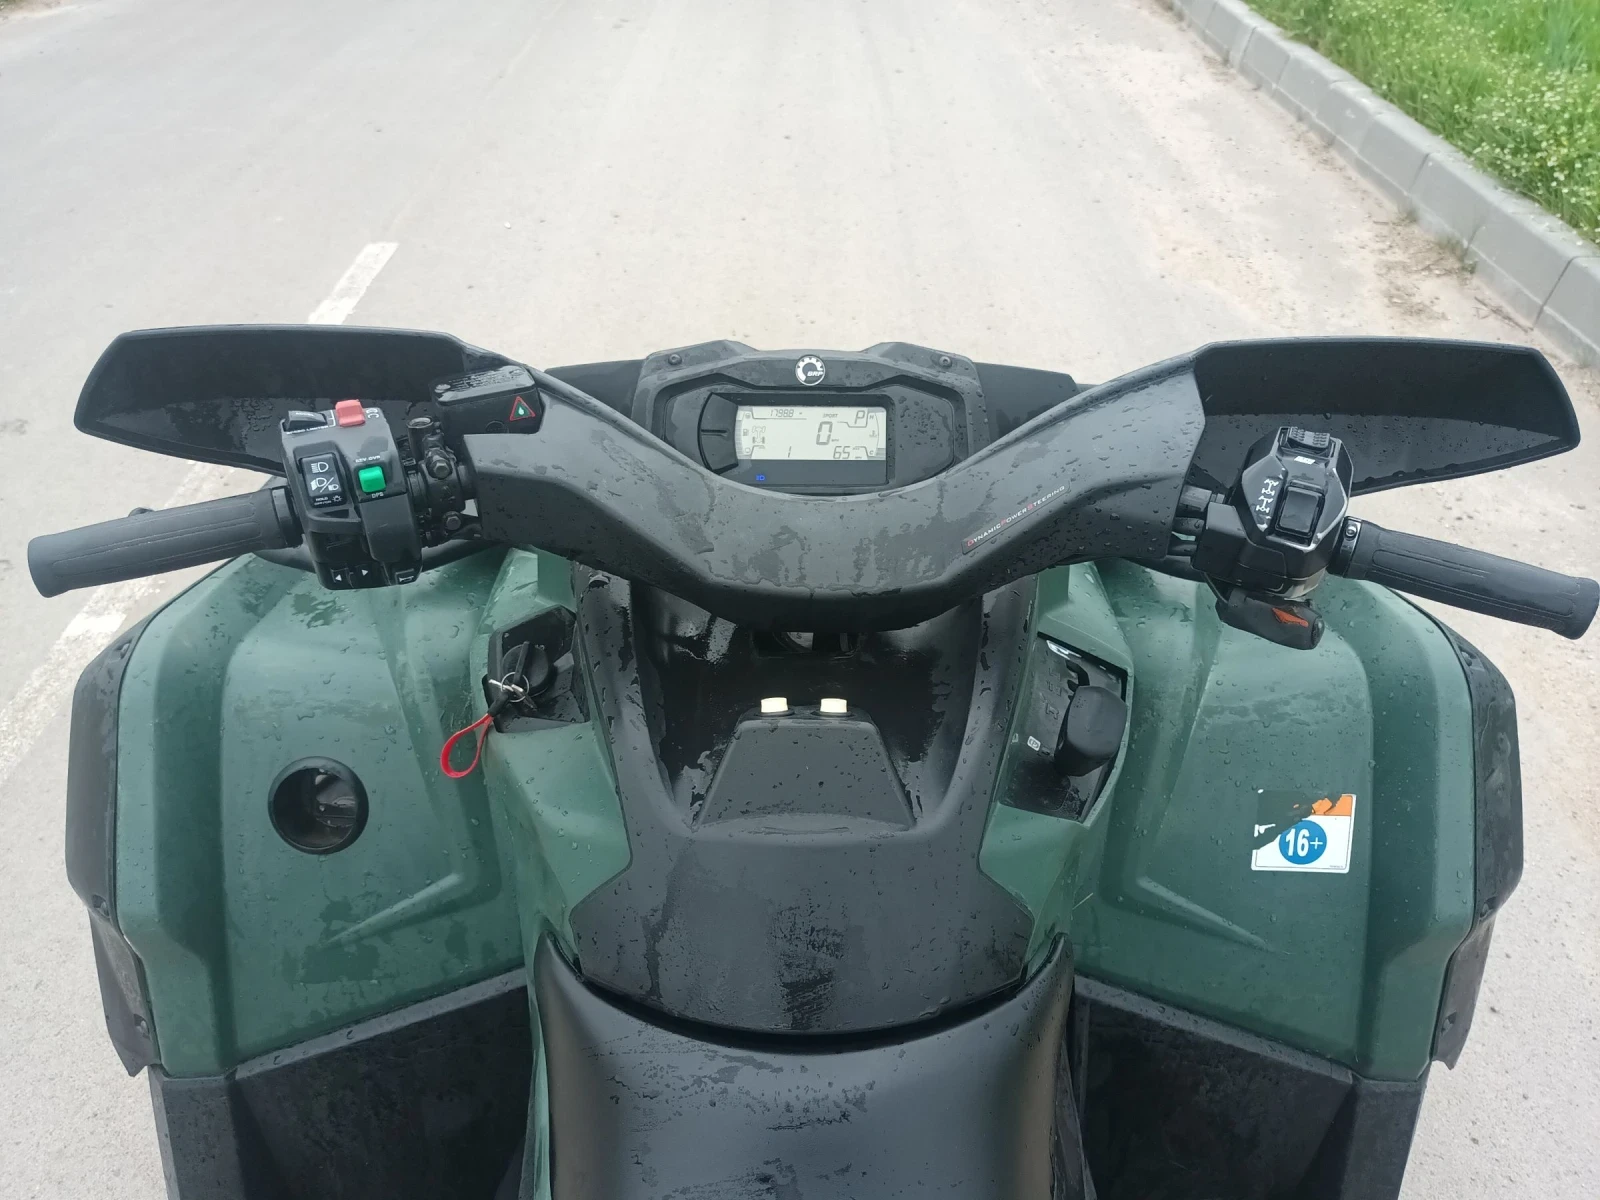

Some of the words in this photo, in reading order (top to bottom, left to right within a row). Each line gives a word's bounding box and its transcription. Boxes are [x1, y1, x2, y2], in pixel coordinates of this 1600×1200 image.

[854, 410, 865, 424] P
[816, 421, 833, 445] 0
[833, 445, 851, 459] 65
[967, 523, 1001, 547] DYNAMIC
[1027, 485, 1065, 511] STEERING
[1285, 828, 1324, 857] 16+
